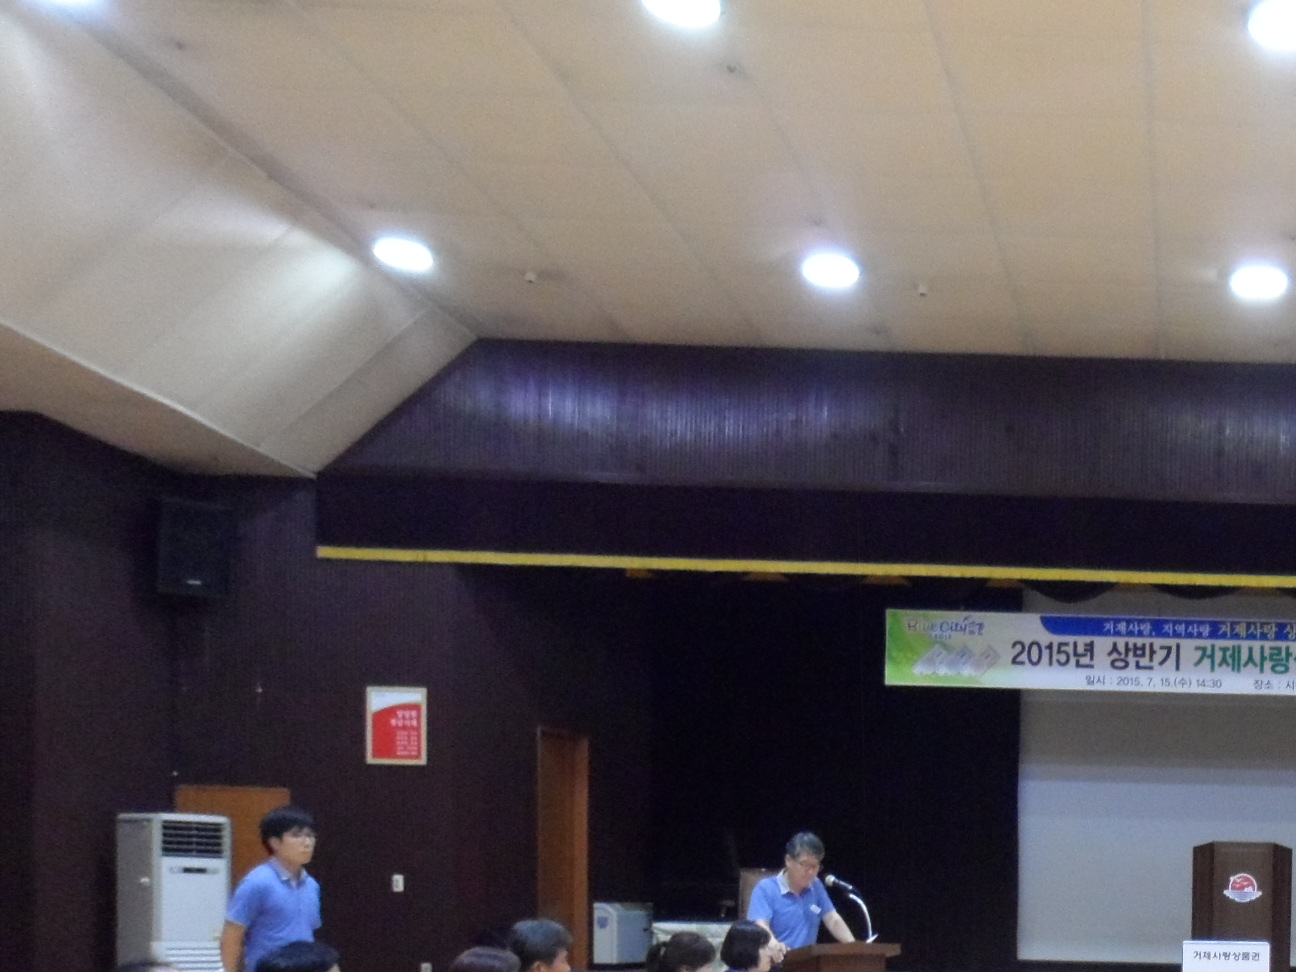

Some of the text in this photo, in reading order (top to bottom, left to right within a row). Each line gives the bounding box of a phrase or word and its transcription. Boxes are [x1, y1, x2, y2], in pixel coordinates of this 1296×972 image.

[1161, 622, 1211, 637] 지역사랑
[1217, 622, 1279, 640] 거제사랑
[1010, 640, 1095, 669] 2015년
[1106, 641, 1182, 672] 상반기
[1085, 674, 1106, 686] 일시
[1116, 676, 1144, 687] 2015.
[1196, 678, 1223, 689] 14:30
[1253, 679, 1274, 691] 장소
[1193, 950, 1260, 962] 거제사랑상품권
